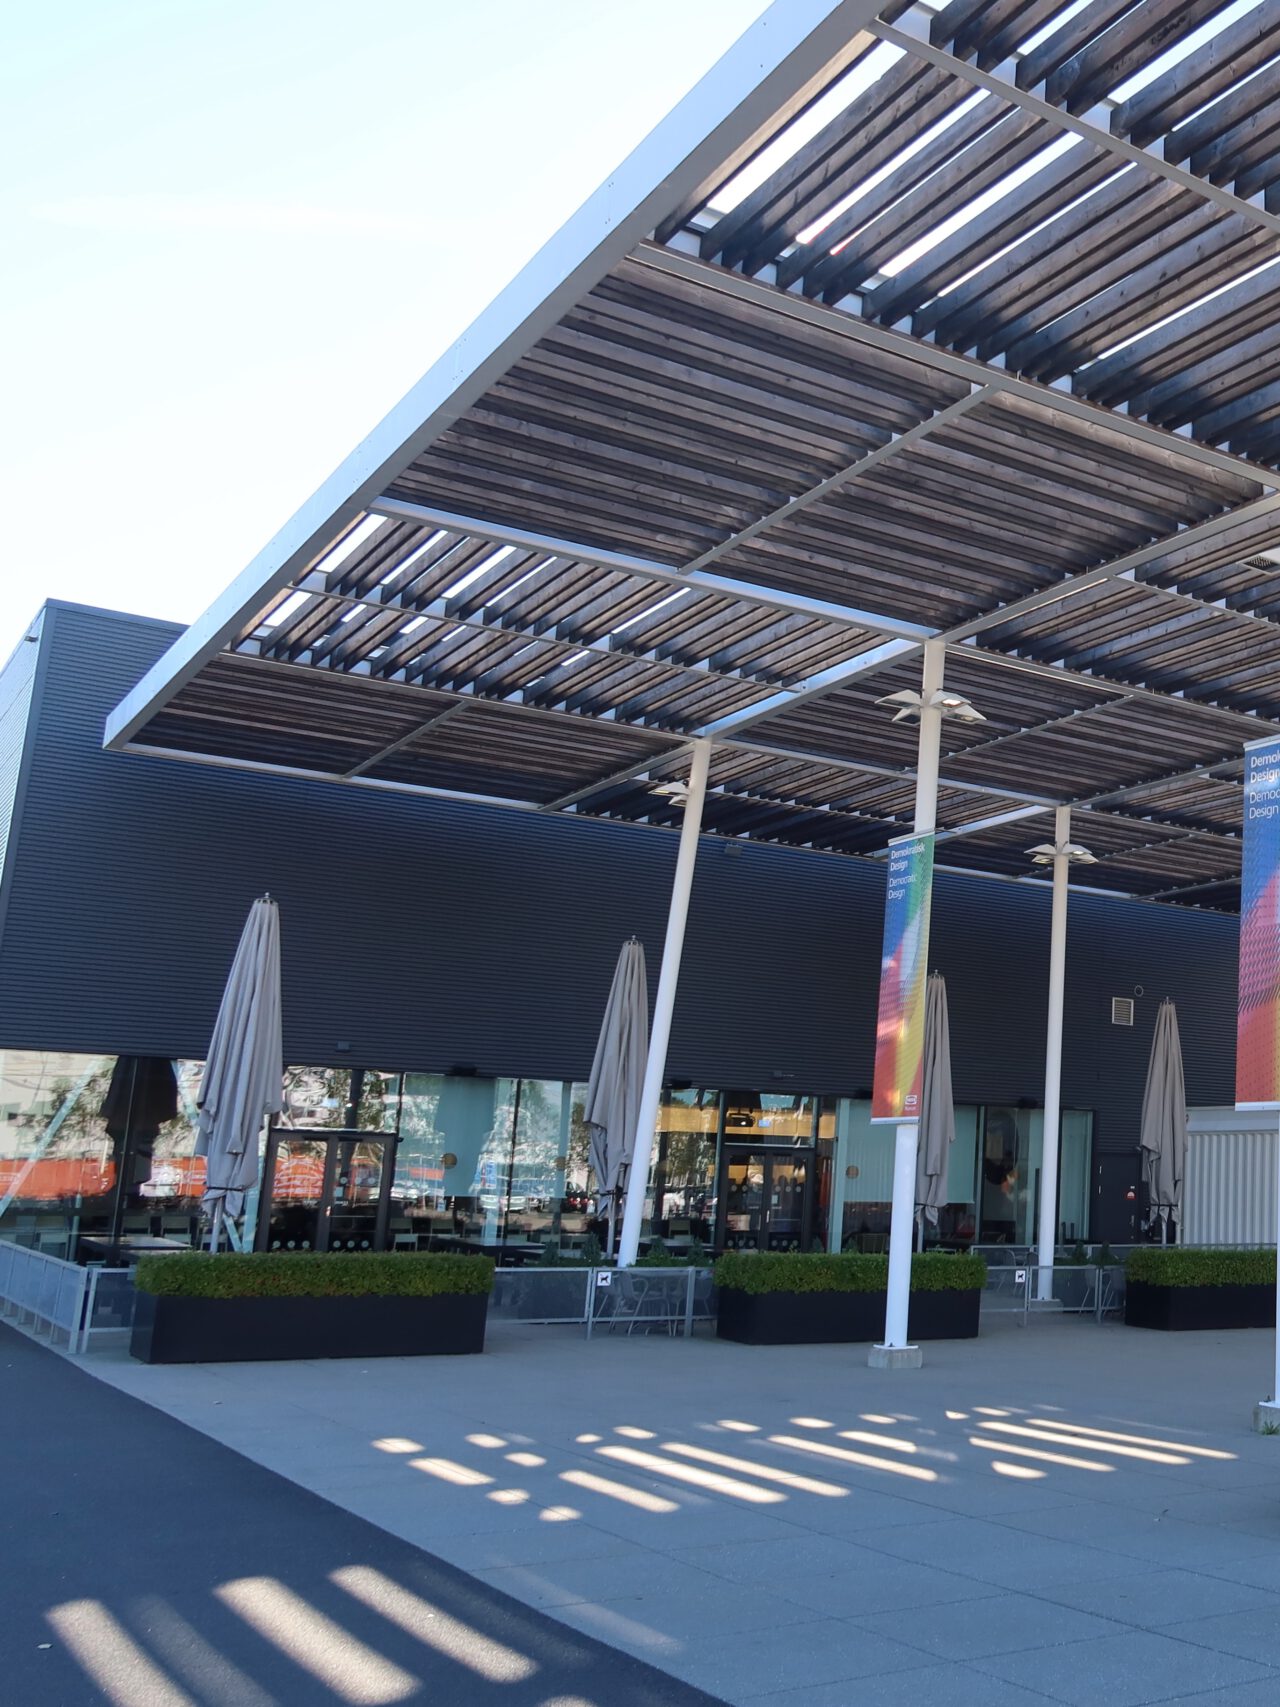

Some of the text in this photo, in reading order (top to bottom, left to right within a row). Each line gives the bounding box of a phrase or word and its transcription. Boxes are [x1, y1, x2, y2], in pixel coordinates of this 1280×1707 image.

[1250, 768, 1280, 783] Design
[1249, 805, 1280, 819] Design
[891, 842, 925, 859] Demokratisk
[890, 860, 908, 872] Design
[888, 889, 905, 900] Design
